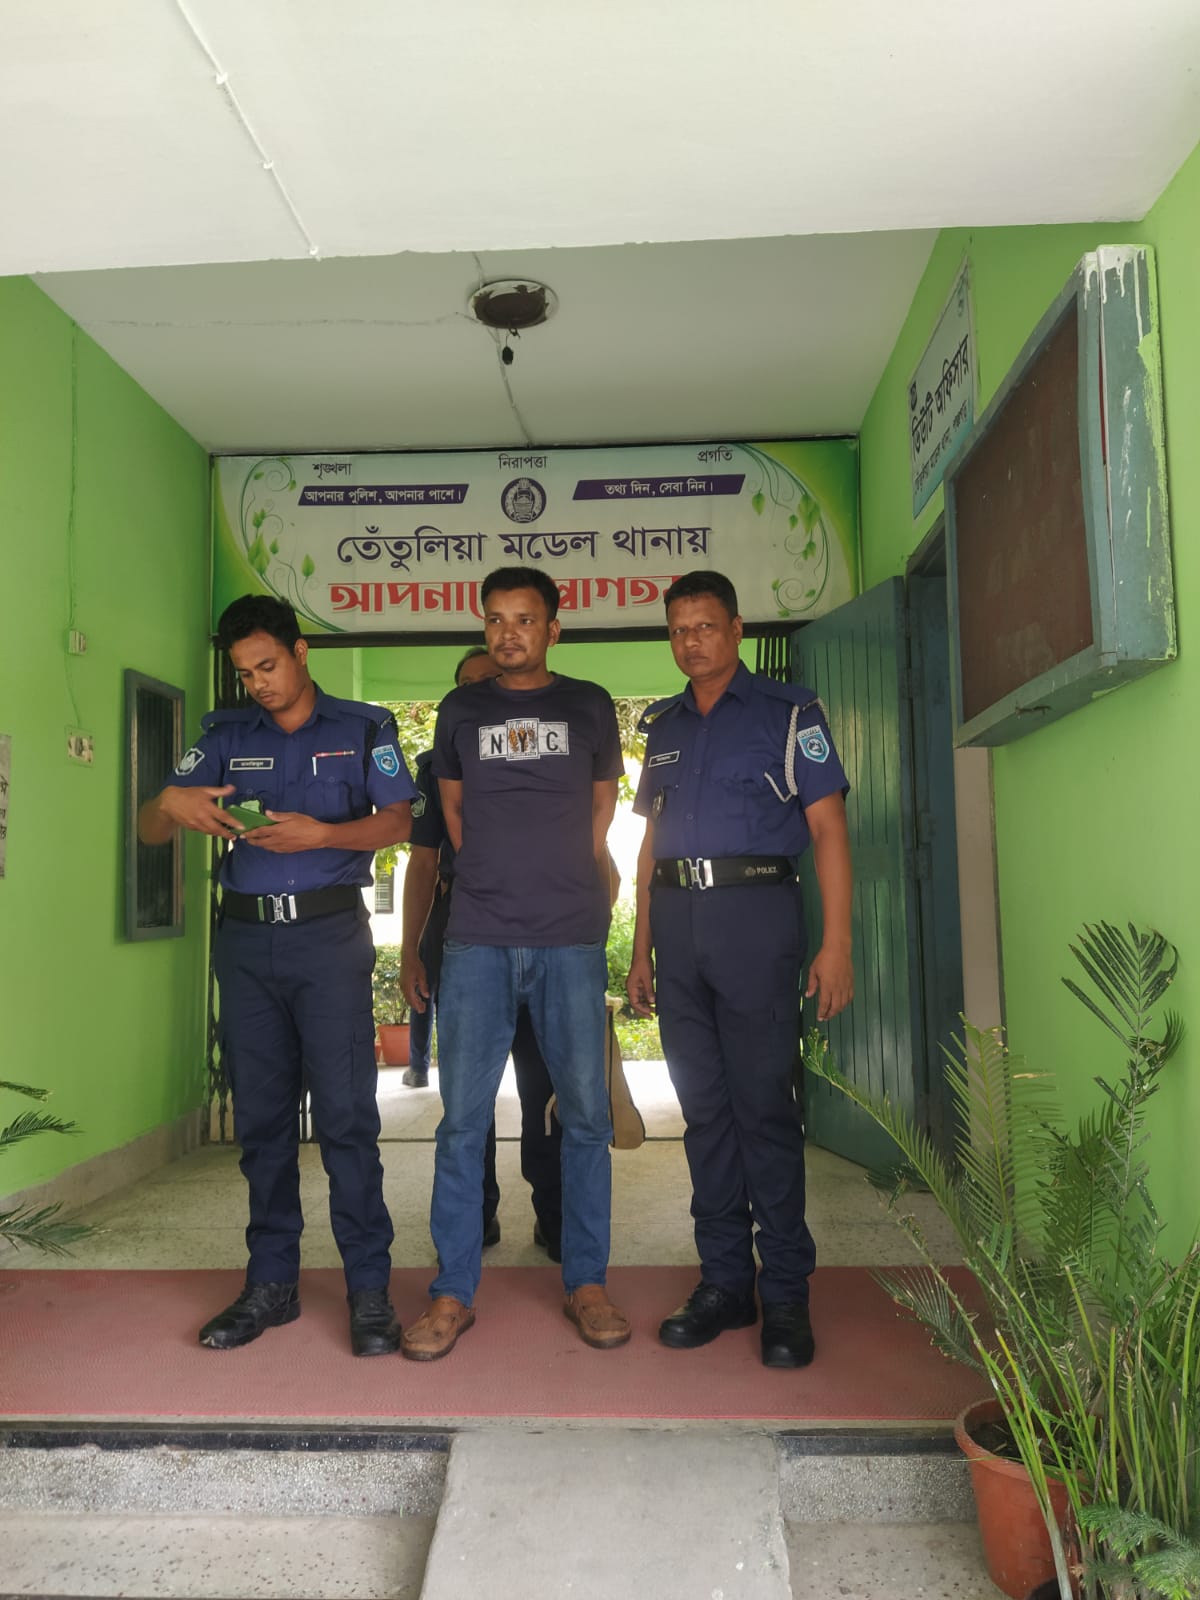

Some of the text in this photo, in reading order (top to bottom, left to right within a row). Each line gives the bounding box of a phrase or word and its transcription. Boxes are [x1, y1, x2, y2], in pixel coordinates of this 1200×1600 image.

[912, 391, 933, 461] ডিউটি
[935, 334, 969, 415] অফিসার
[499, 454, 547, 470] নিরাপত্তা
[697, 445, 733, 463] প্রগতি
[312, 462, 352, 480] শৃঙ্খলা
[304, 490, 345, 503] আপনার
[384, 489, 425, 502] আপনার
[604, 483, 627, 495] তথ্য
[659, 481, 683, 494] সেবা
[337, 525, 712, 572] তেঁতুলিয়া মডেল থানায়
[551, 575, 685, 611] স্বাগত
